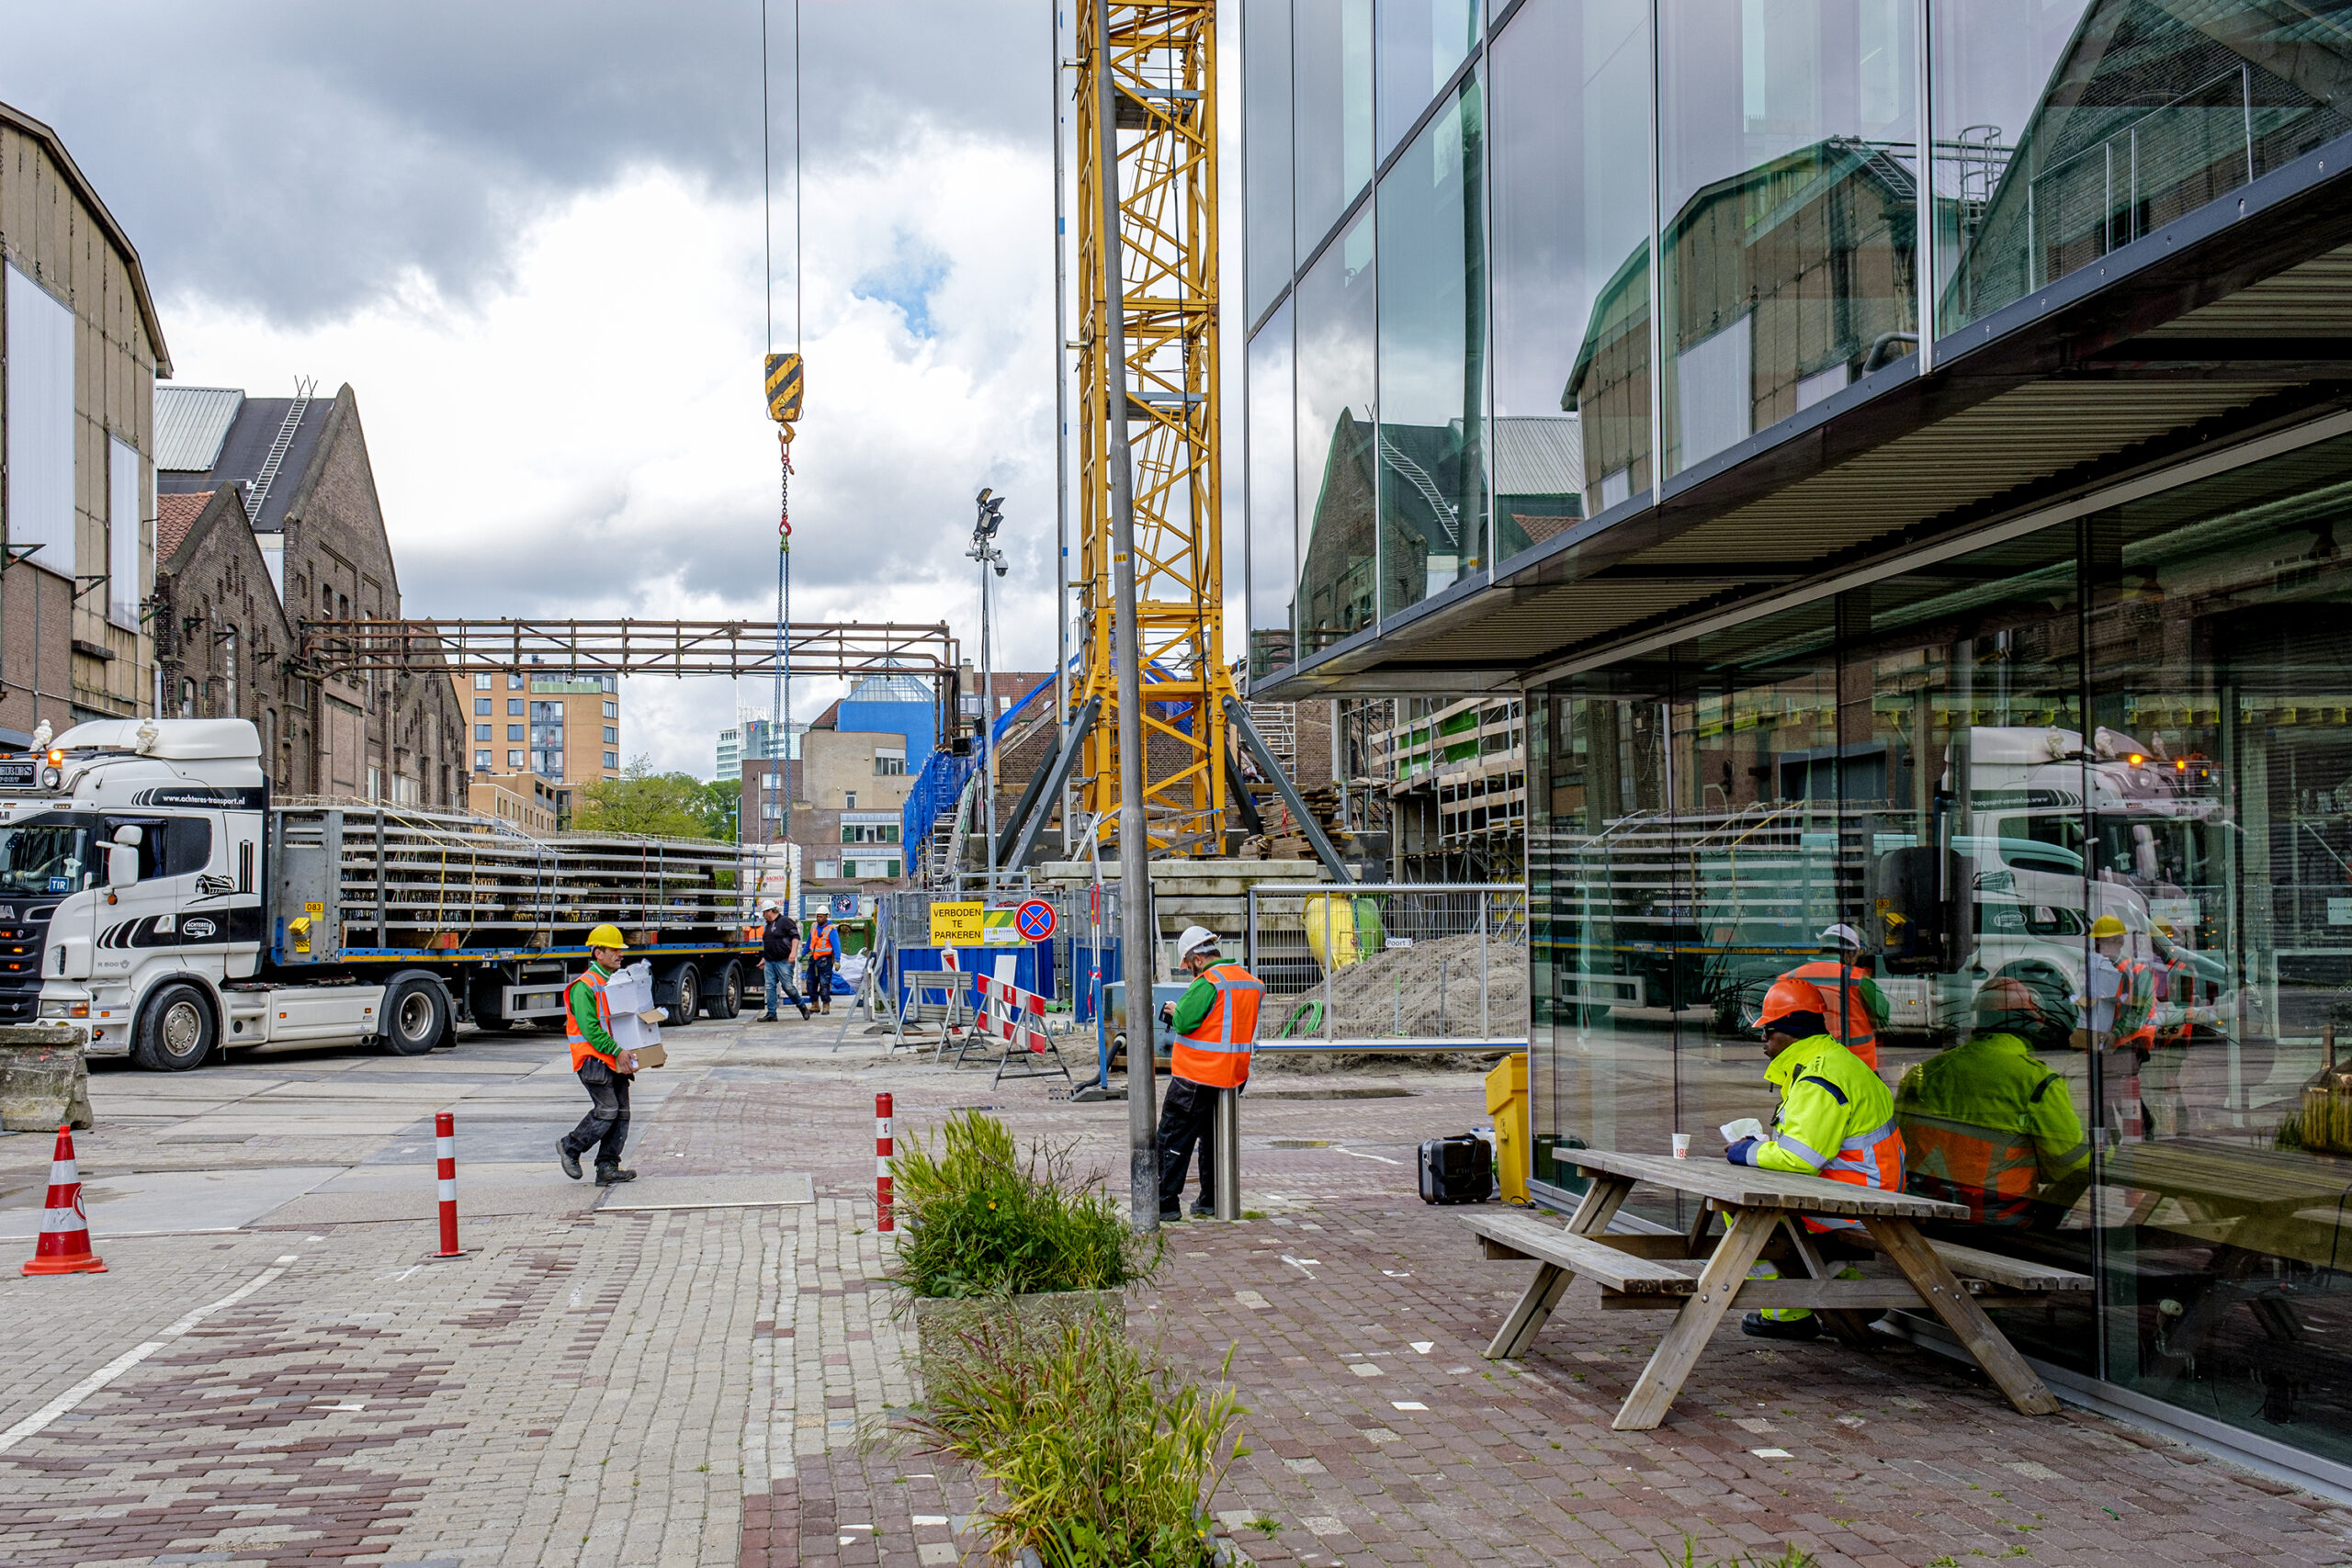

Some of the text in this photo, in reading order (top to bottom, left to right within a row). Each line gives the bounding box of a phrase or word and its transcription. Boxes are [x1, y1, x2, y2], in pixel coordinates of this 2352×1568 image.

[163, 794, 245, 806] www.achteres-transport.nl
[52, 880, 66, 889] TIR
[307, 903, 322, 911] 083
[933, 908, 981, 917] VERBODEN
[952, 919, 963, 928] TE
[934, 931, 981, 939] PARKEREN
